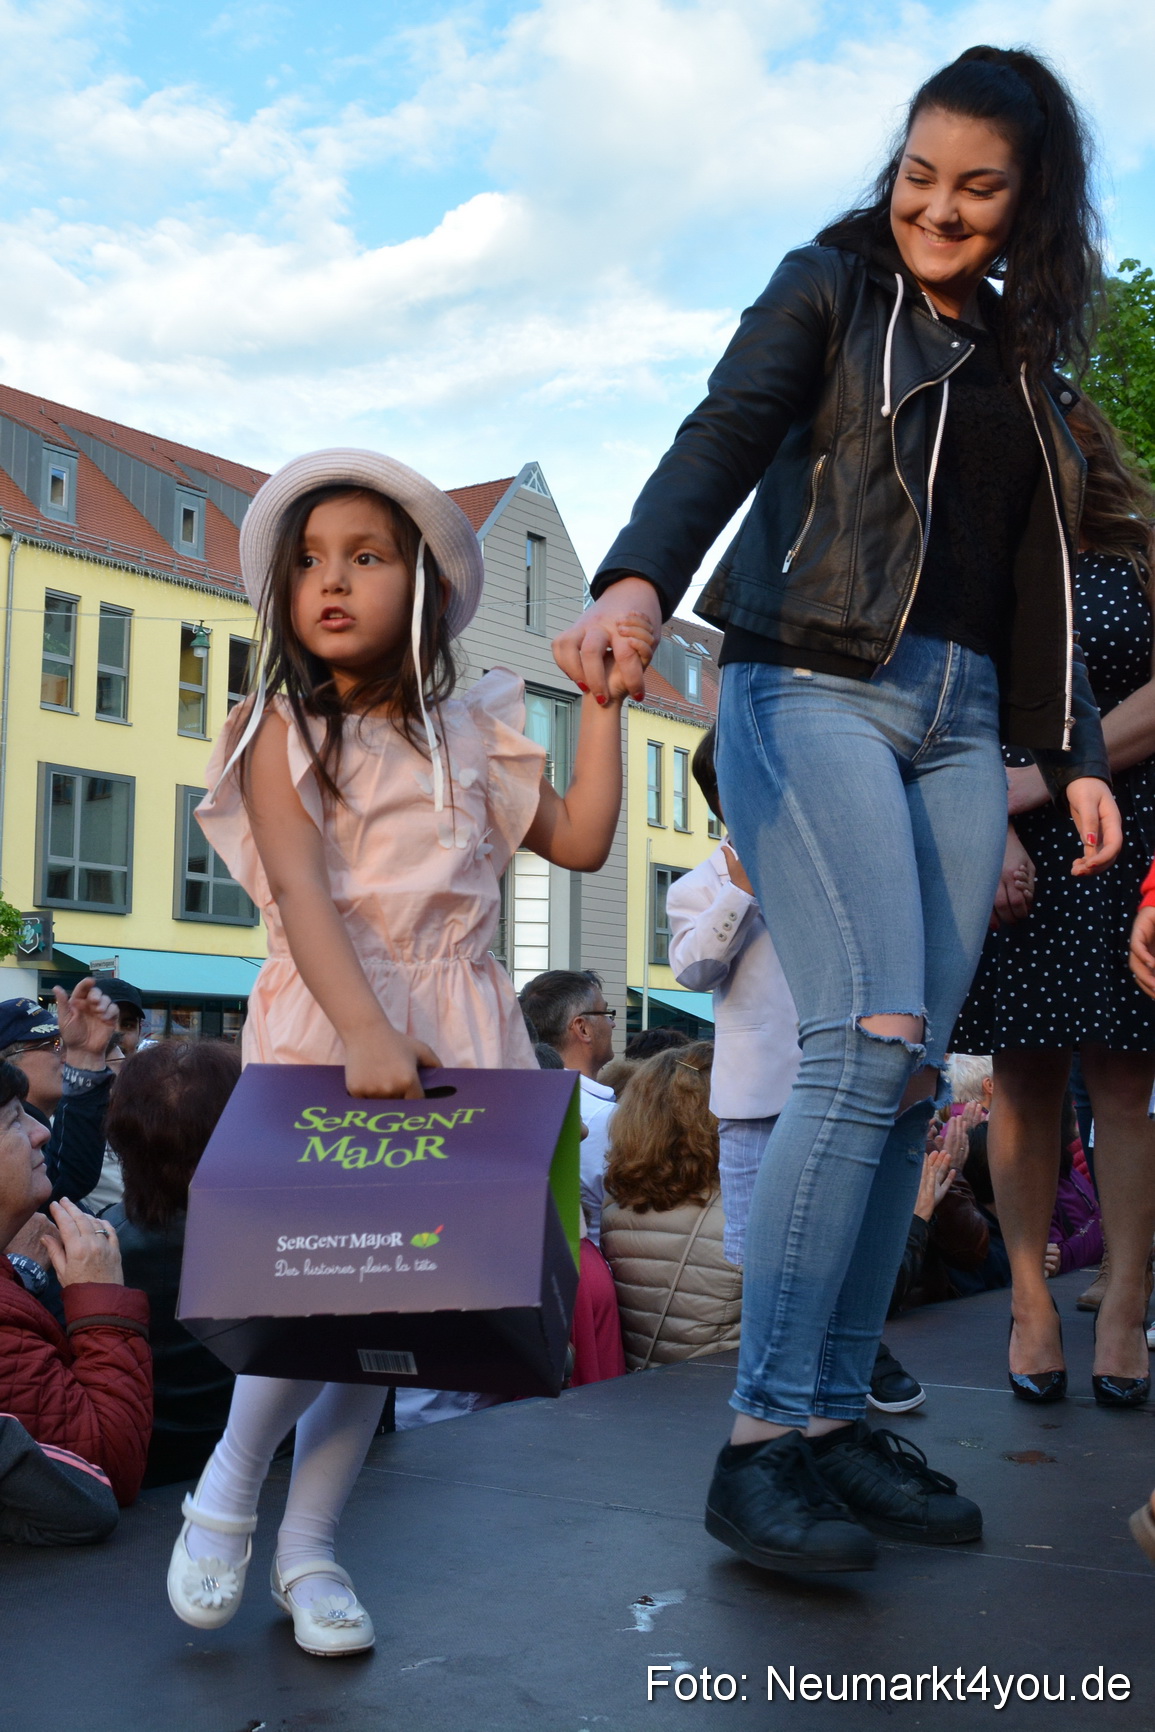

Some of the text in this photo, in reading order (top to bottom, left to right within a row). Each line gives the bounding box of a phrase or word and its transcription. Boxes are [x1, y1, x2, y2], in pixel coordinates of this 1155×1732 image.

[274, 1259, 299, 1277] Des
[303, 1258, 356, 1276] histoires
[395, 1254, 411, 1272] la
